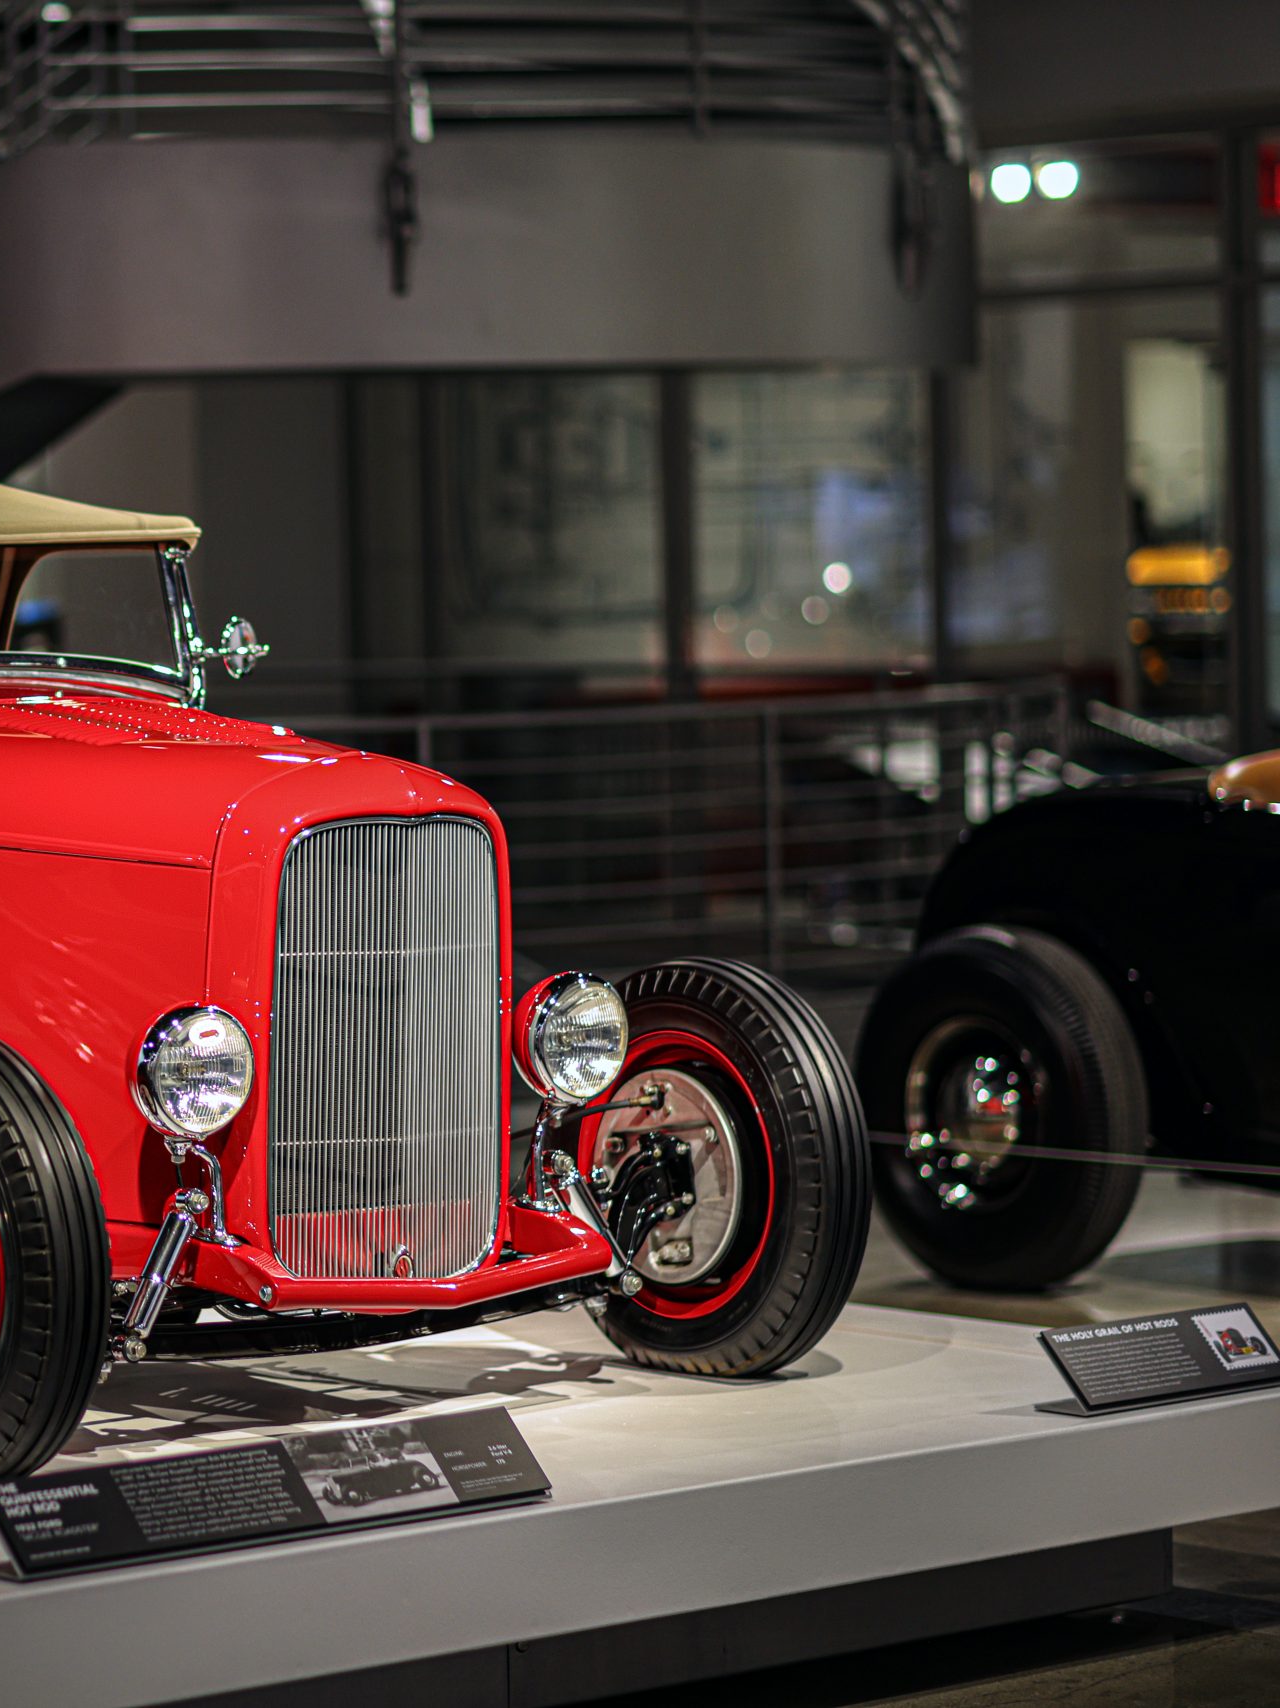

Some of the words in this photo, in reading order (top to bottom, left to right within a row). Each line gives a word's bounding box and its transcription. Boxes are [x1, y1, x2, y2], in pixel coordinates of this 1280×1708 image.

[1052, 1334, 1071, 1343] THE
[1071, 1330, 1094, 1341] HOLY
[1095, 1326, 1121, 1337] GRAIL
[1121, 1324, 1133, 1333] OF
[1134, 1321, 1153, 1332] HOT
[1153, 1318, 1179, 1329] RODS
[0, 1484, 99, 1506] QUINTESSENTIAL
[5, 1503, 31, 1518] HOT
[33, 1500, 61, 1515] ROD
